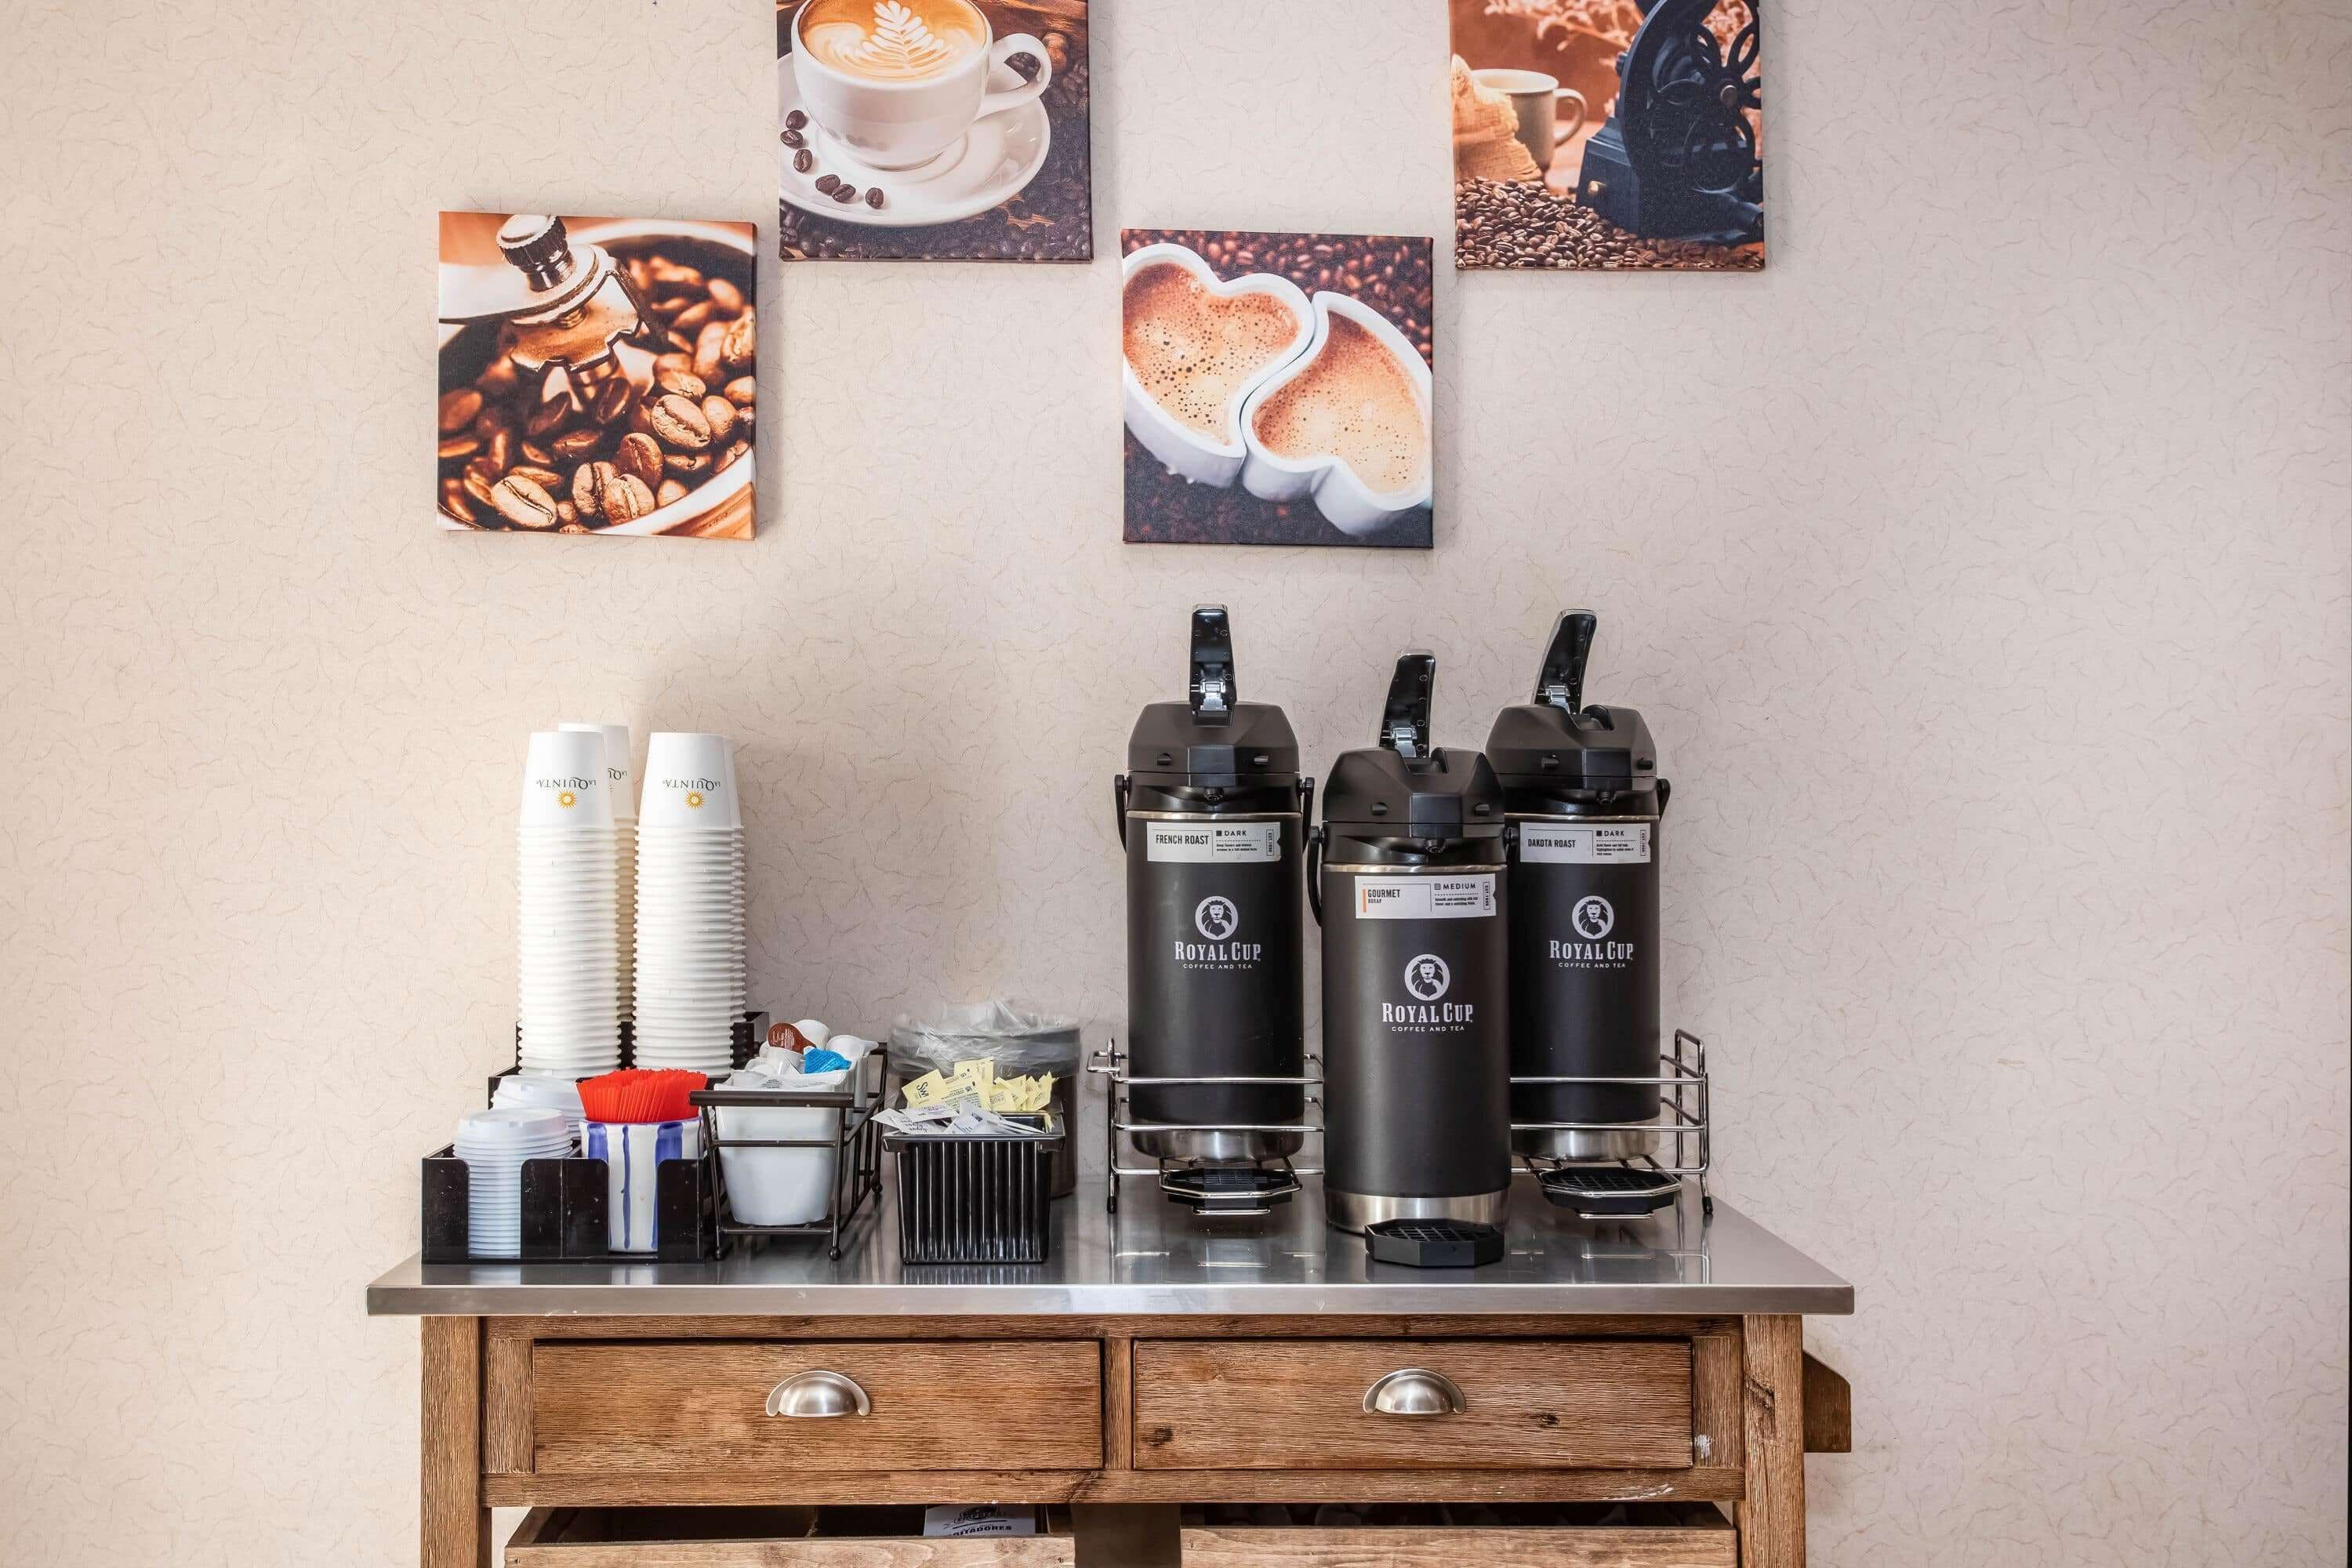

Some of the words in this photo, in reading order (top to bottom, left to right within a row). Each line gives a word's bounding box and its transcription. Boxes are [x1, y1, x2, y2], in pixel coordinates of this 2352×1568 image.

[1156, 834, 1182, 845] FRENCH
[1185, 835, 1210, 845] ROAST
[1527, 838, 1552, 848] DAKOTA
[1554, 839, 1576, 848] ROAST
[1367, 889, 1401, 898] GOURMET
[1174, 941, 1227, 960] ROYAL
[1231, 942, 1261, 960] CUP
[1549, 940, 1603, 960] ROYAL
[1607, 941, 1633, 960] CUP
[1382, 1003, 1439, 1023] ROYAL
[1443, 1002, 1473, 1022] CUP
